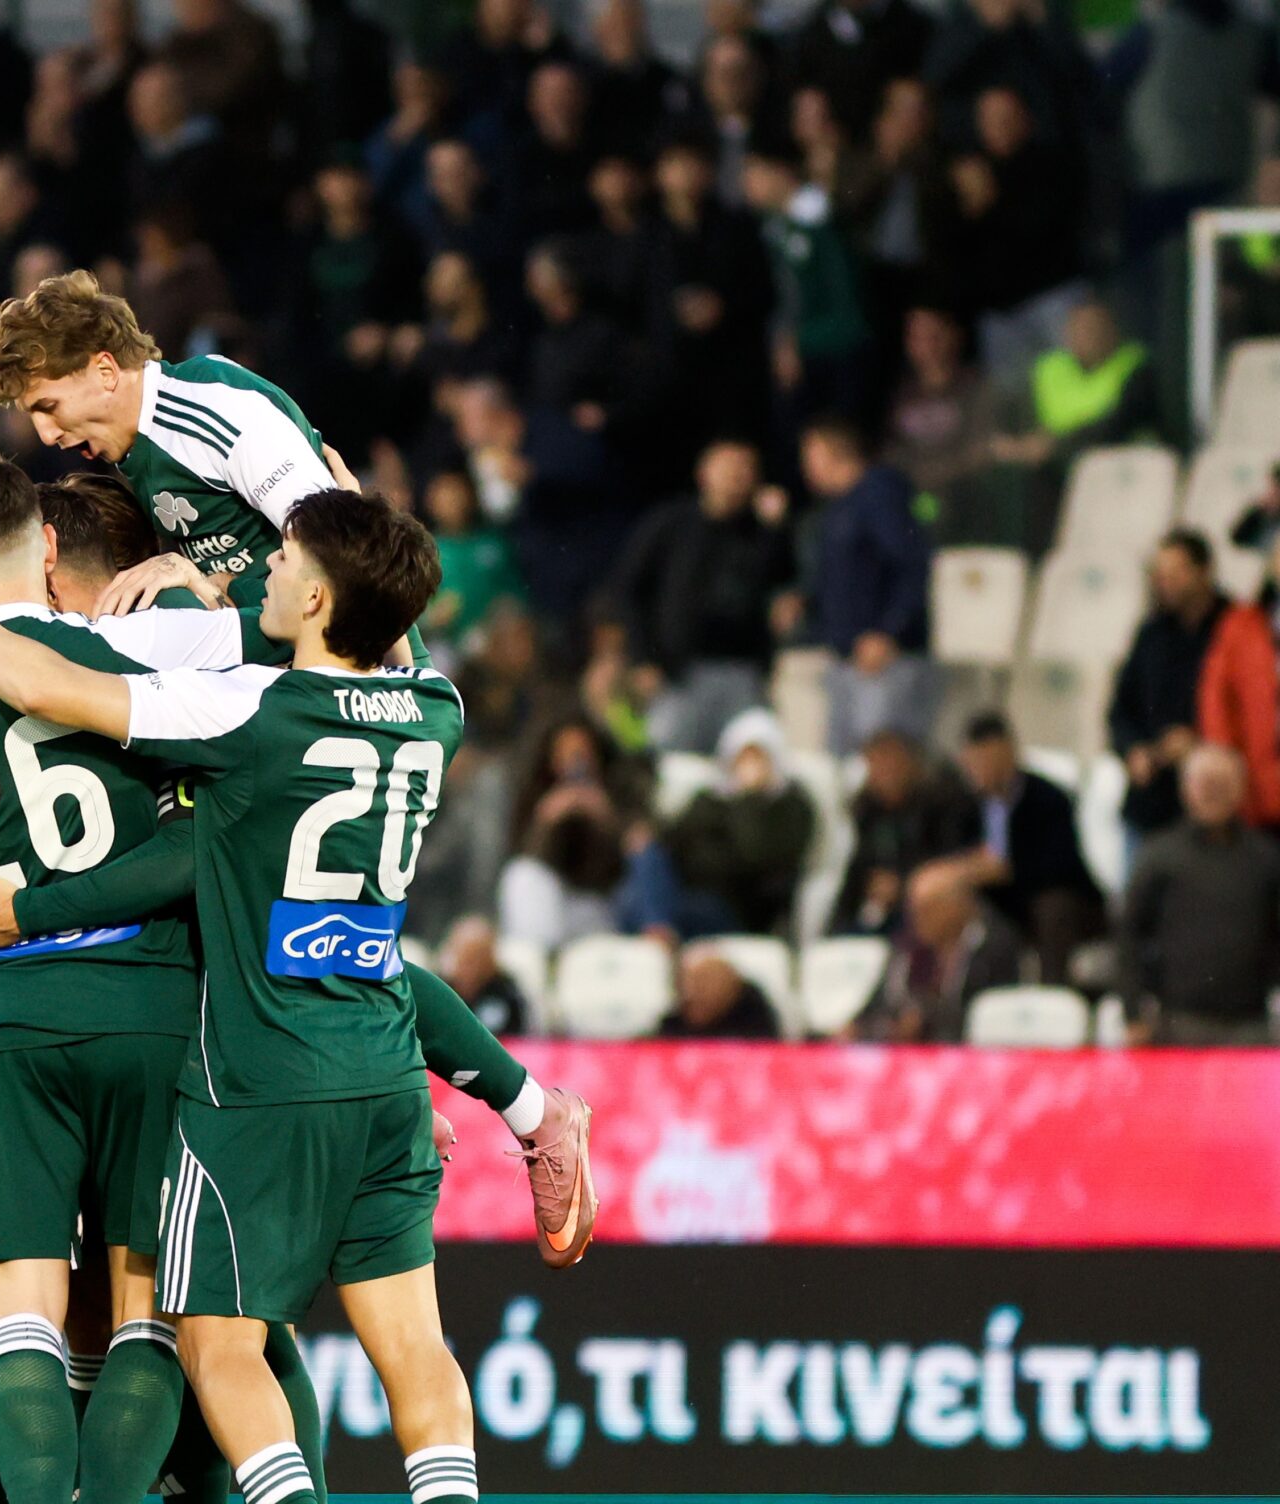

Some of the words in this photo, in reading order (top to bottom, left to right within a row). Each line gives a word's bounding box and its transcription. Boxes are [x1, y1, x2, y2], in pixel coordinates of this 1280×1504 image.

[253, 459, 295, 502] Piraeus
[185, 534, 239, 563] Little
[207, 548, 254, 577] lter
[333, 688, 424, 723] TABORDA
[282, 737, 444, 902] 20
[476, 1296, 697, 1470] ό,τι
[722, 1303, 1213, 1452] κινείται
